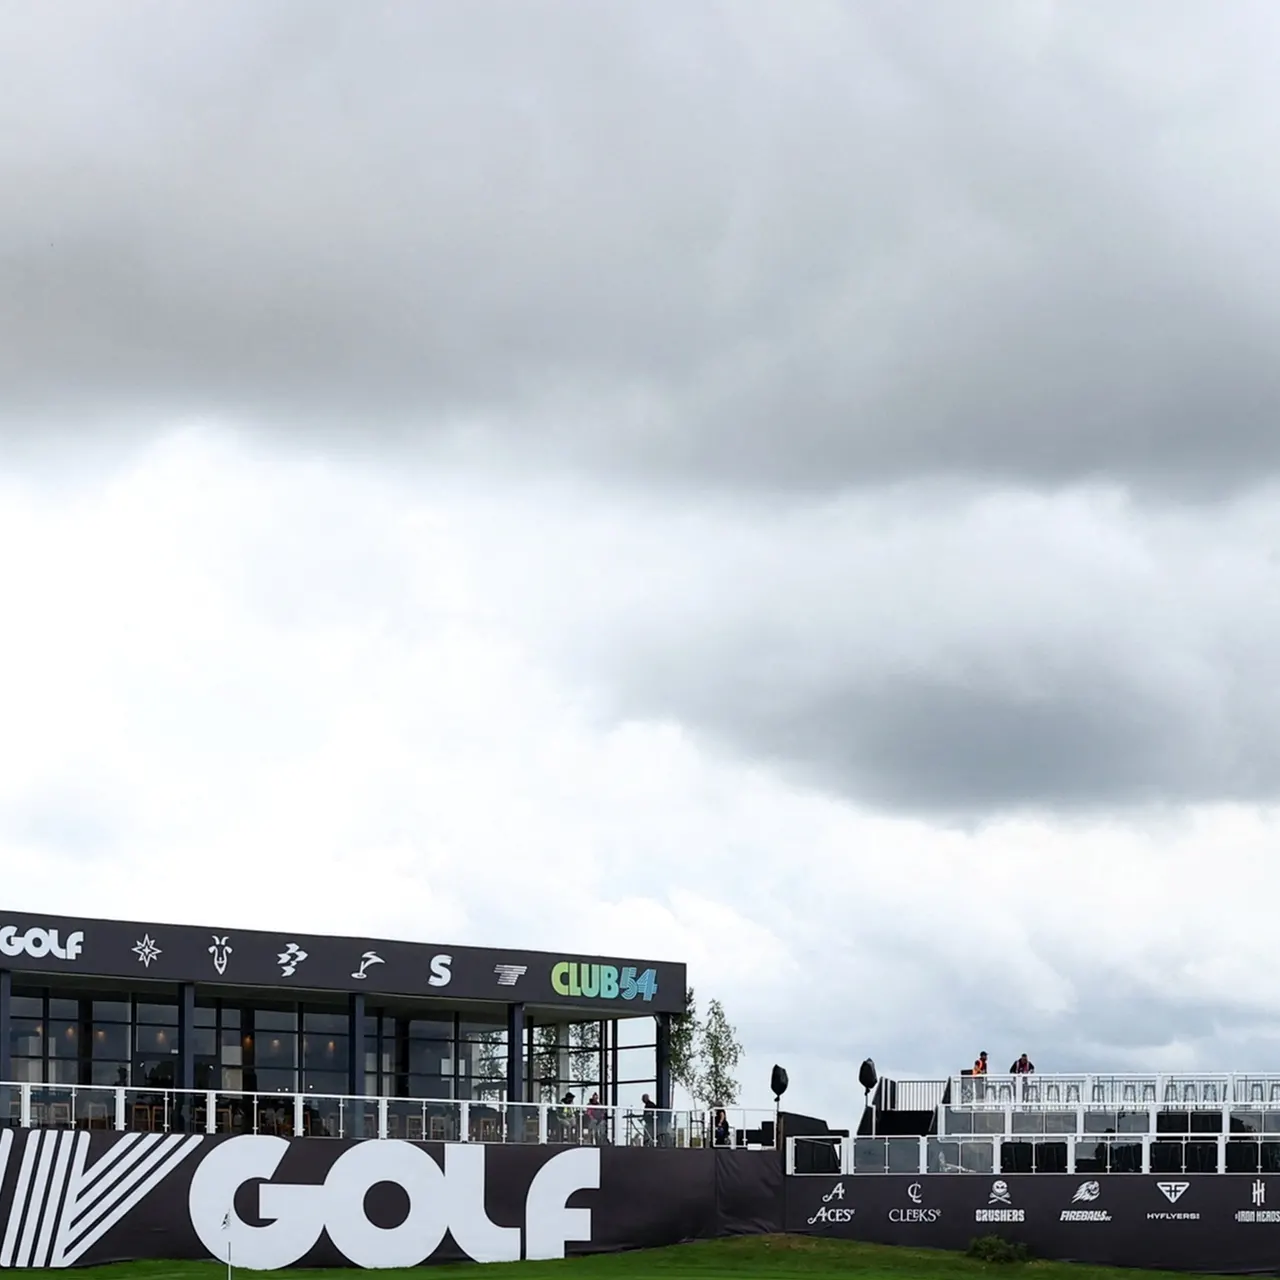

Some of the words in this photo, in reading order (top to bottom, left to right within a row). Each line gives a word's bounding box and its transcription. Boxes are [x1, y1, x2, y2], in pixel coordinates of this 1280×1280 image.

[551, 961, 619, 999] CLUB
[619, 966, 658, 1002] 54
[188, 1134, 601, 1270] GOLF
[888, 1208, 937, 1222] CLEEKS
[975, 1209, 1025, 1222] CRUSHERS
